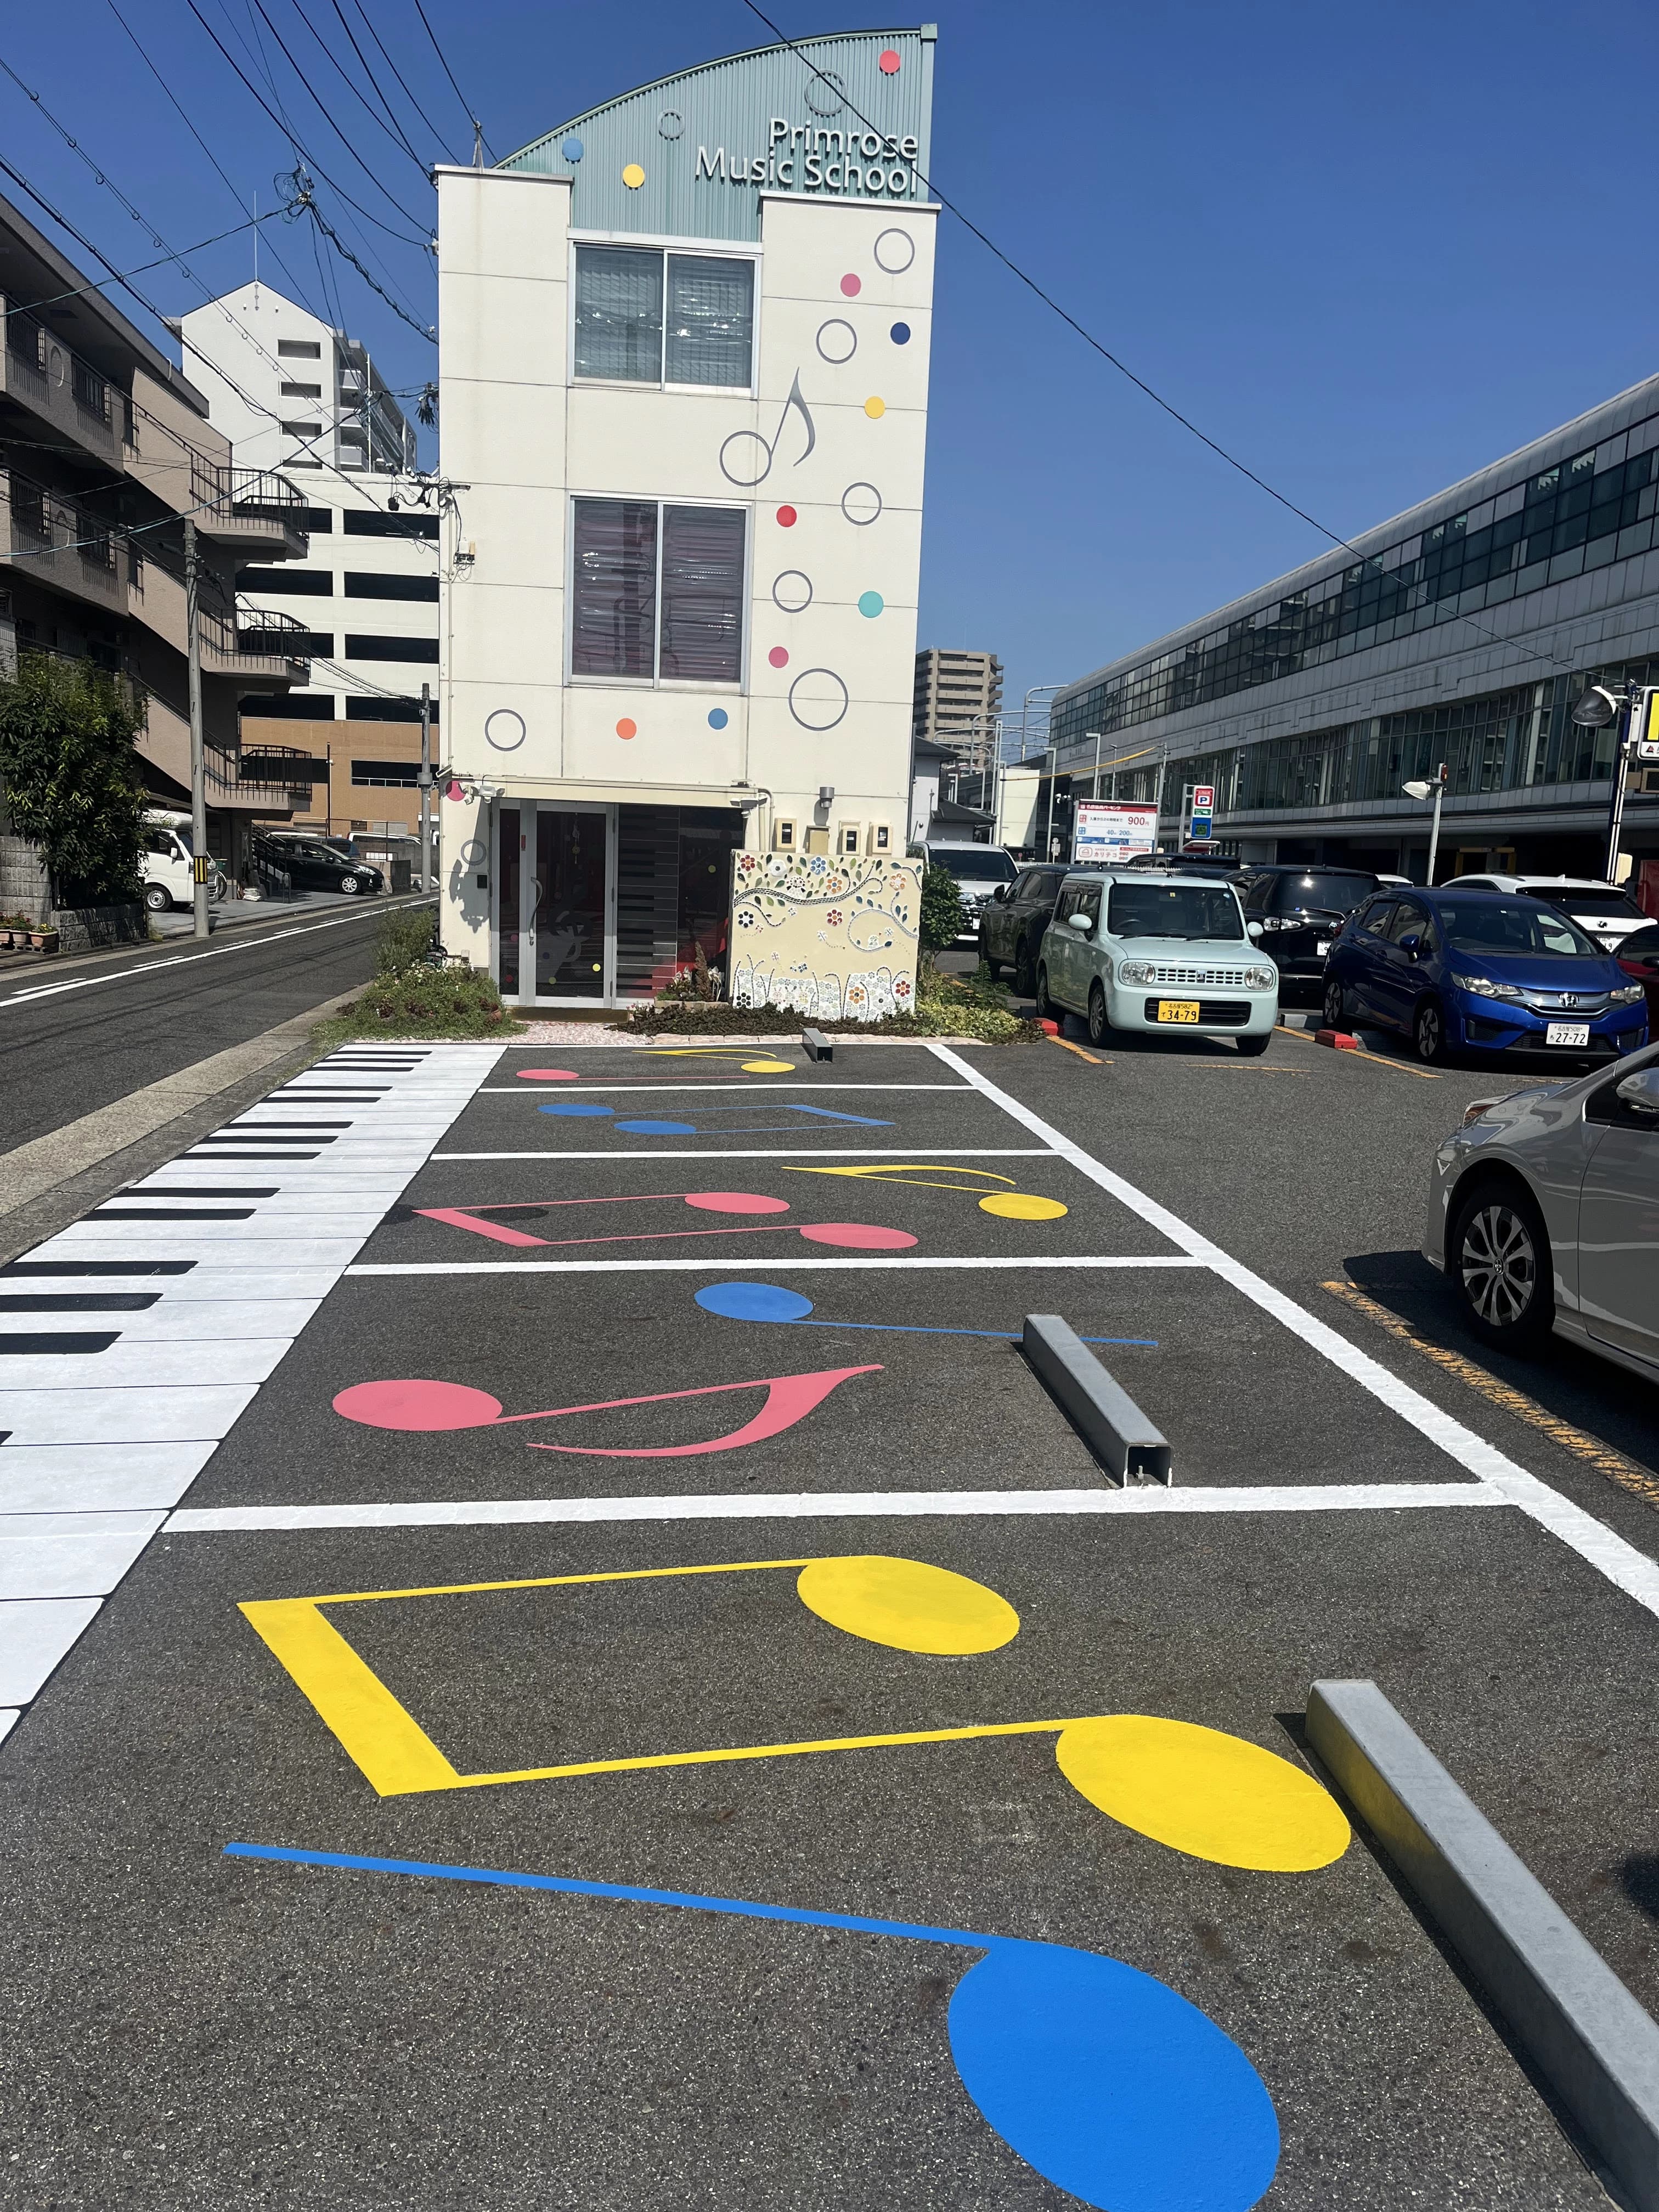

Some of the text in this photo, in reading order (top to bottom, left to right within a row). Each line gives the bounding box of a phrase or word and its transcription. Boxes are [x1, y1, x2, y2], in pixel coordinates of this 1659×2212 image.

[770, 117, 919, 159] Primrose
[696, 146, 917, 193] Music School
[1167, 1010, 1197, 1021] 34-79
[1555, 1032, 1586, 1044] 27-72
